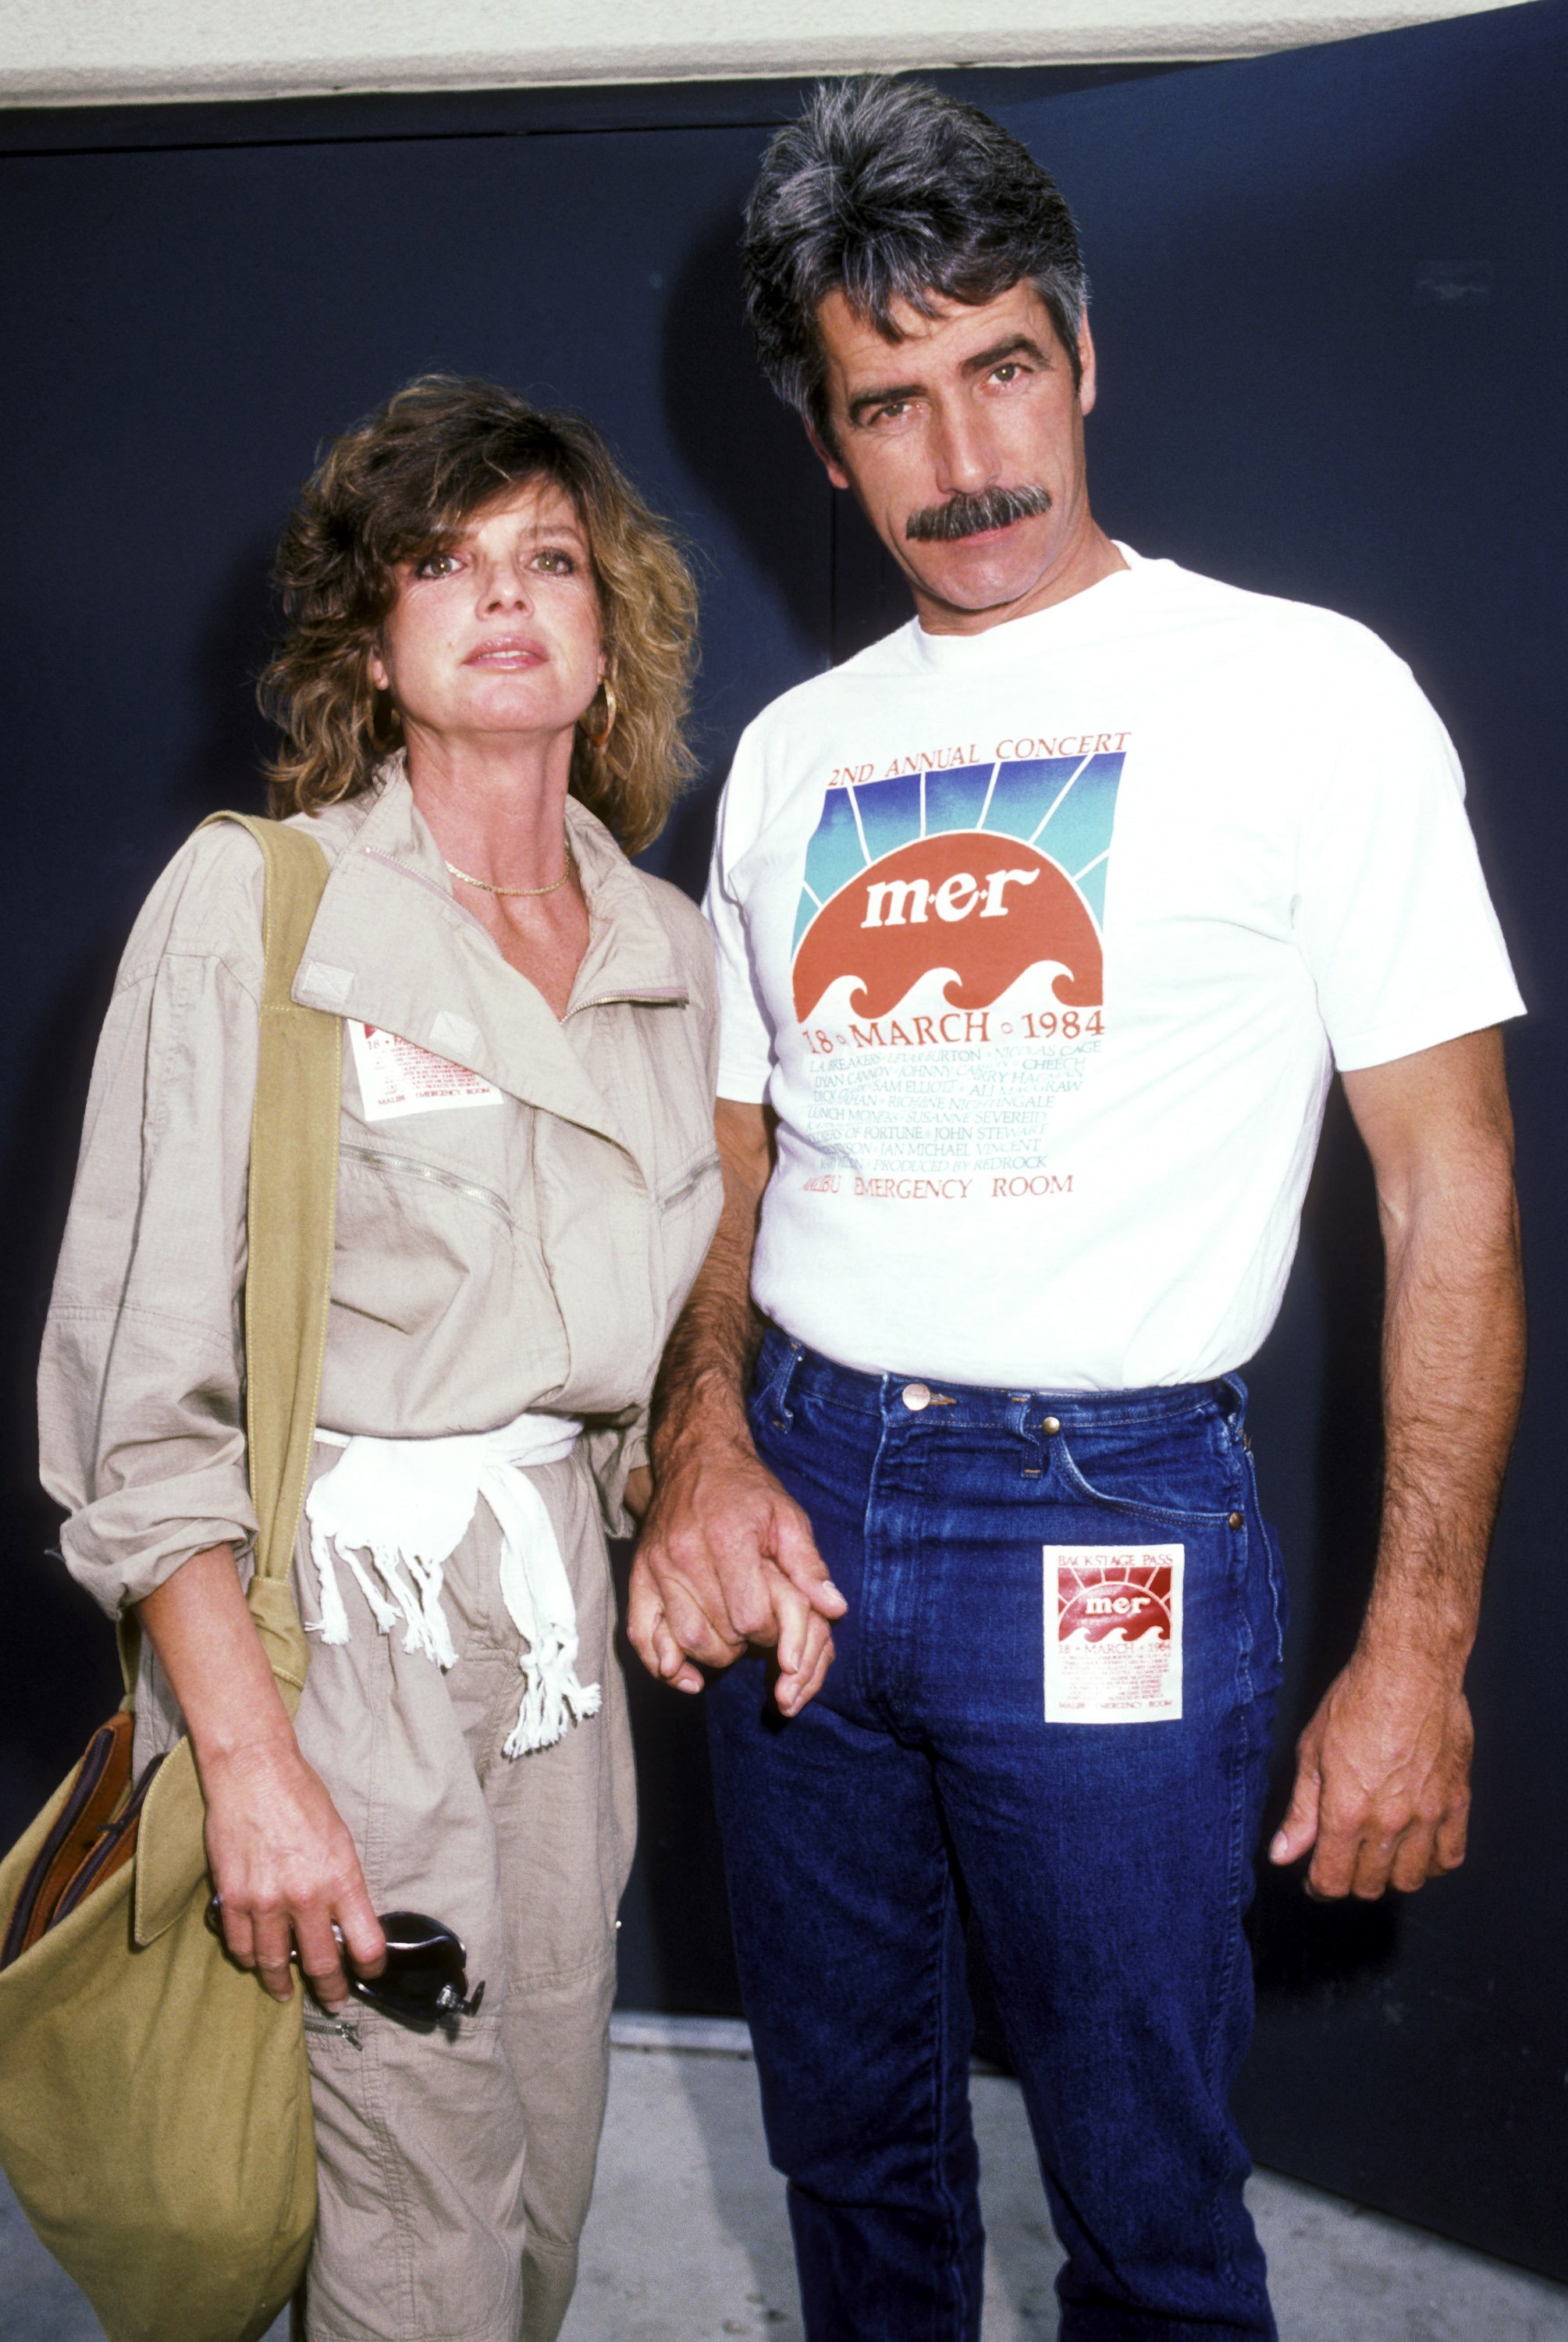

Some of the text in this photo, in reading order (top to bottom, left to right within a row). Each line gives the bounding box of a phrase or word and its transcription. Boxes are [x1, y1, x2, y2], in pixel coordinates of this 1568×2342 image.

[827, 731, 1132, 787] 2ND ANNUAL CONCERT
[802, 1009, 1106, 1055] 18 MARCH 1984
[1059, 1039, 1102, 1056] CAGE
[814, 1073, 844, 1087] DYAN
[898, 1064, 951, 1077] JOHNNY
[1022, 1057, 1086, 1070] CHEECH
[872, 1079, 902, 1093] SAM
[863, 1126, 924, 1140] FORTUNE
[933, 1127, 973, 1142] JOHN
[976, 1123, 1049, 1141] STEWART
[906, 1143, 969, 1157] MICHAEL
[975, 1137, 1042, 1156] VINCENT
[873, 1159, 950, 1173] PRODUCED
[951, 1160, 969, 1173] BY
[972, 1155, 1048, 1172] REDROCK
[853, 1176, 973, 1199] EMERGENCY
[991, 1173, 1074, 1198] ROOM
[1058, 1554, 1174, 1567] BACKSTAGE PASS
